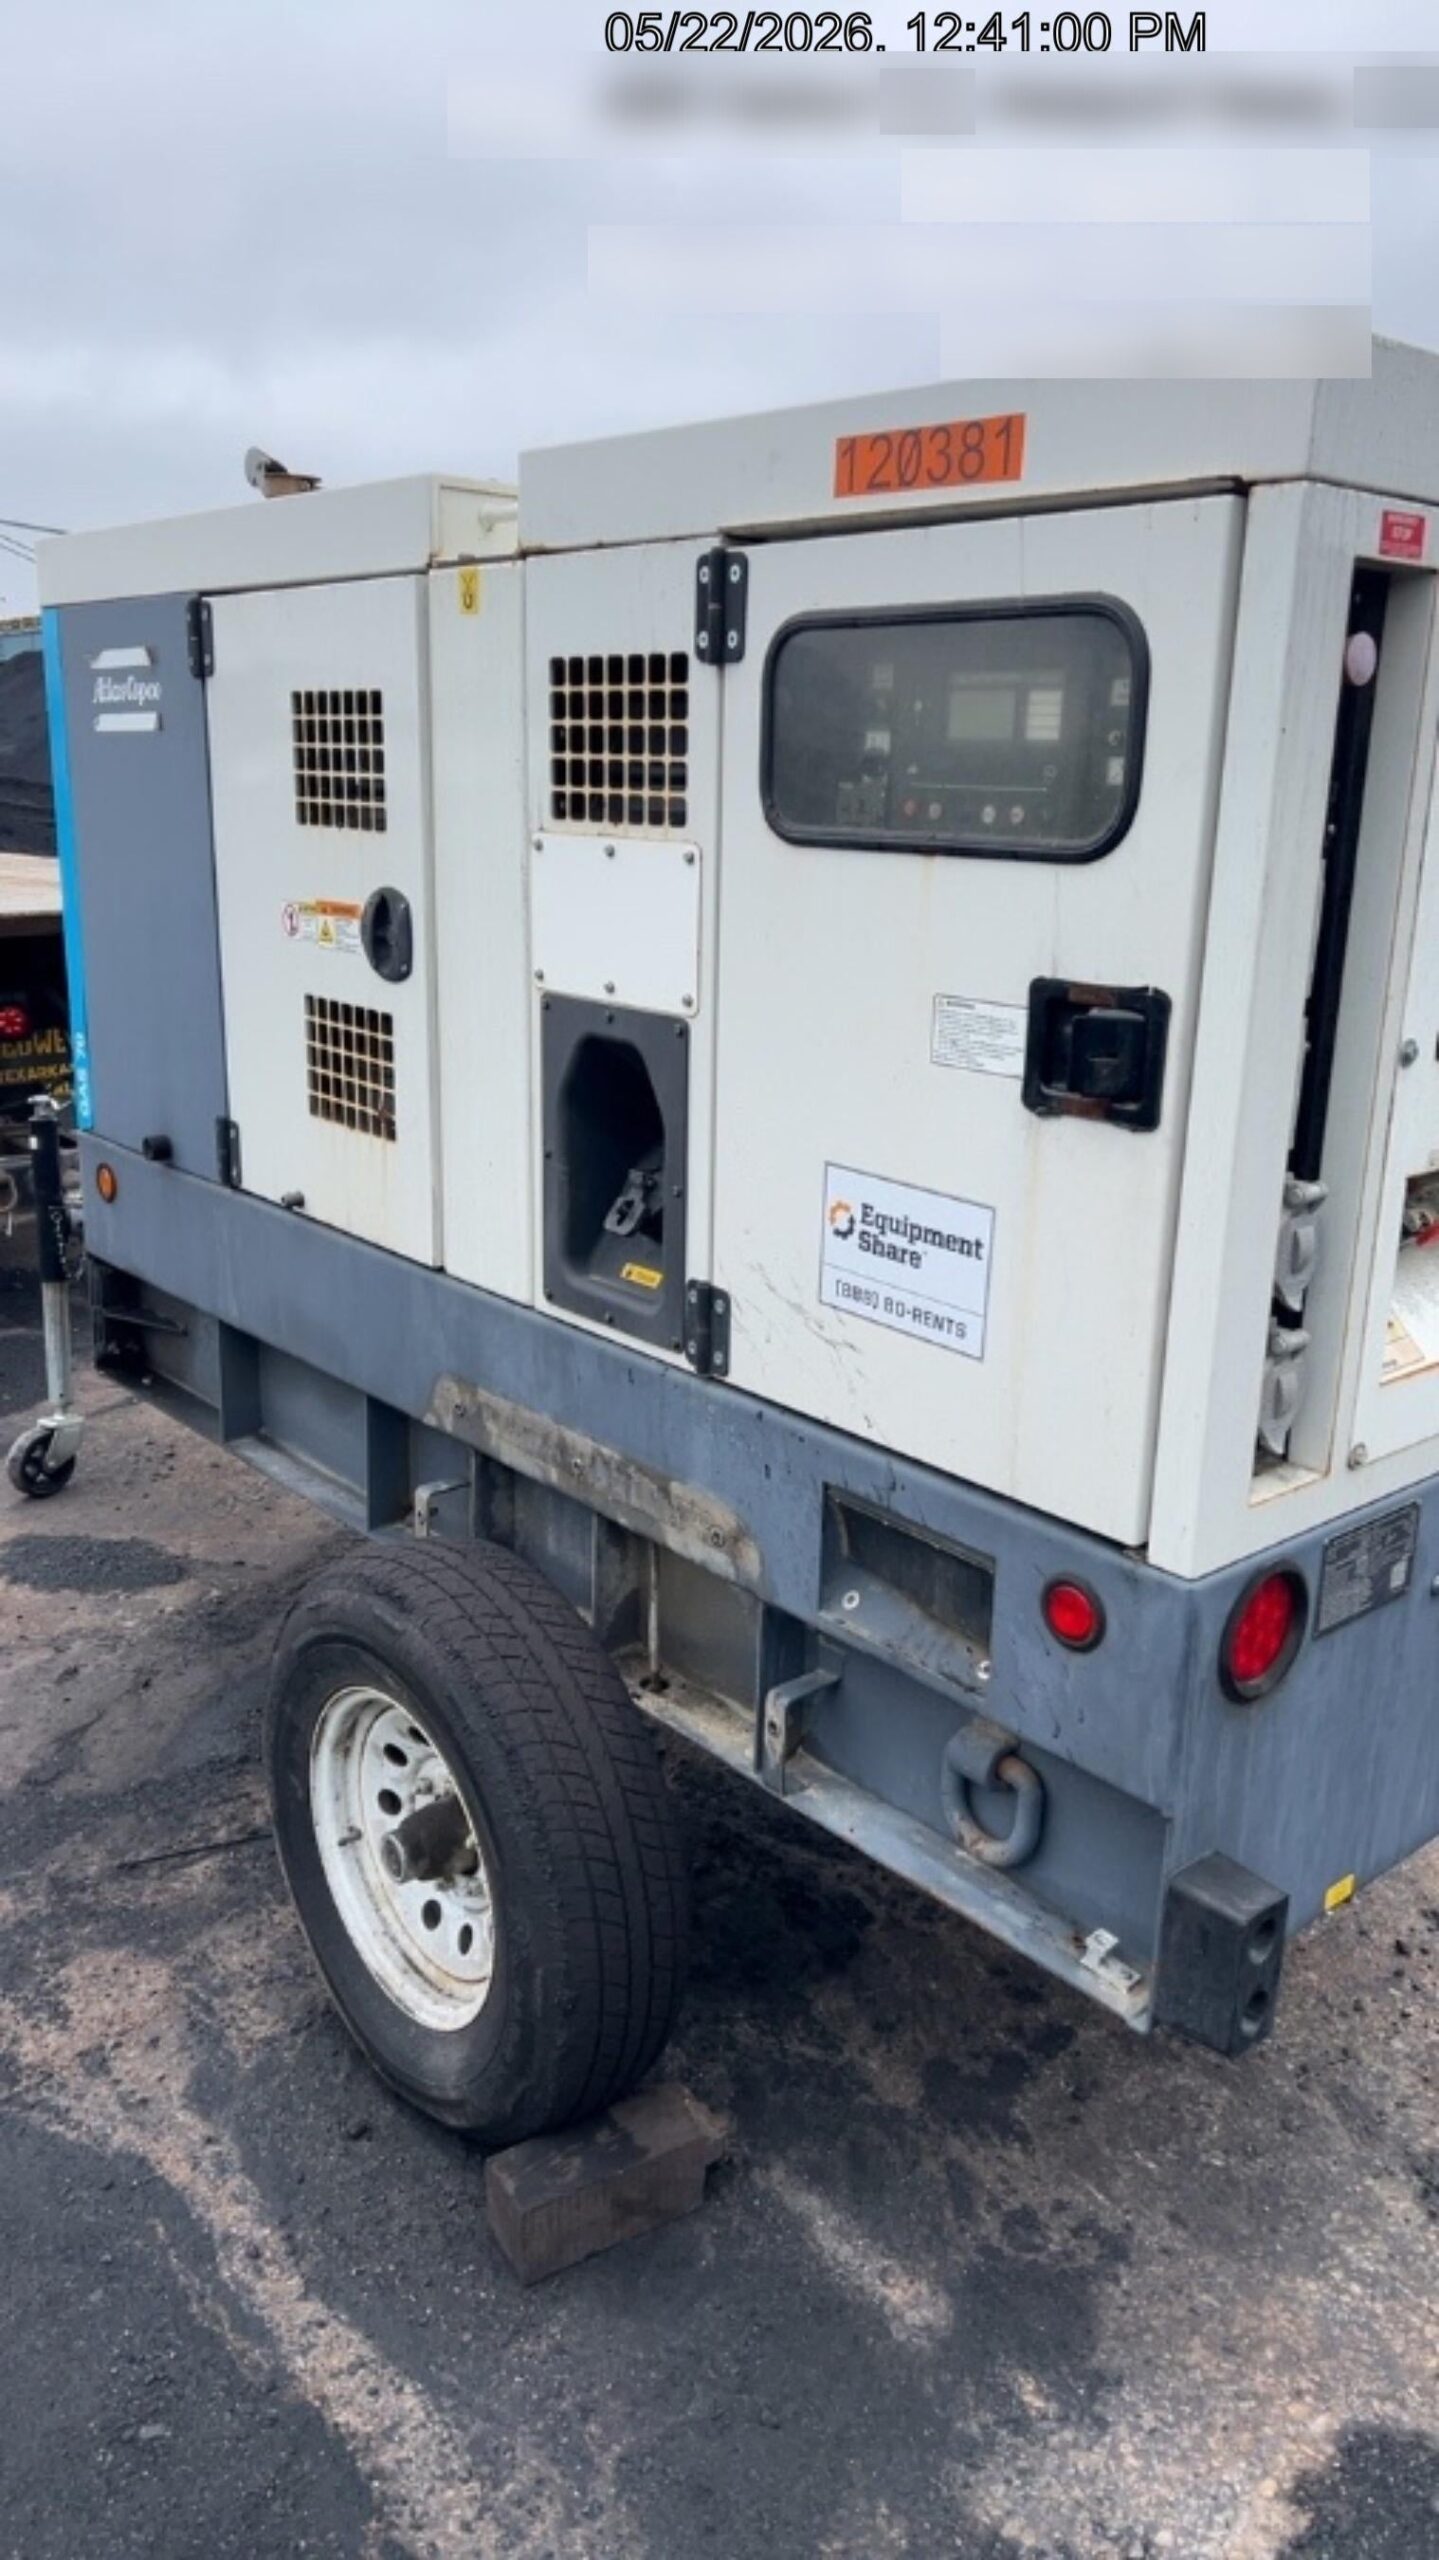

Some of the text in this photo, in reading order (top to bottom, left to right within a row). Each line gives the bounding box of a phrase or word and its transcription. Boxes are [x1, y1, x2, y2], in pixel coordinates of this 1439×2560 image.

[839, 415, 1014, 495] 120381
[858, 1230, 923, 1269] Share
[860, 1202, 984, 1260] Equipment
